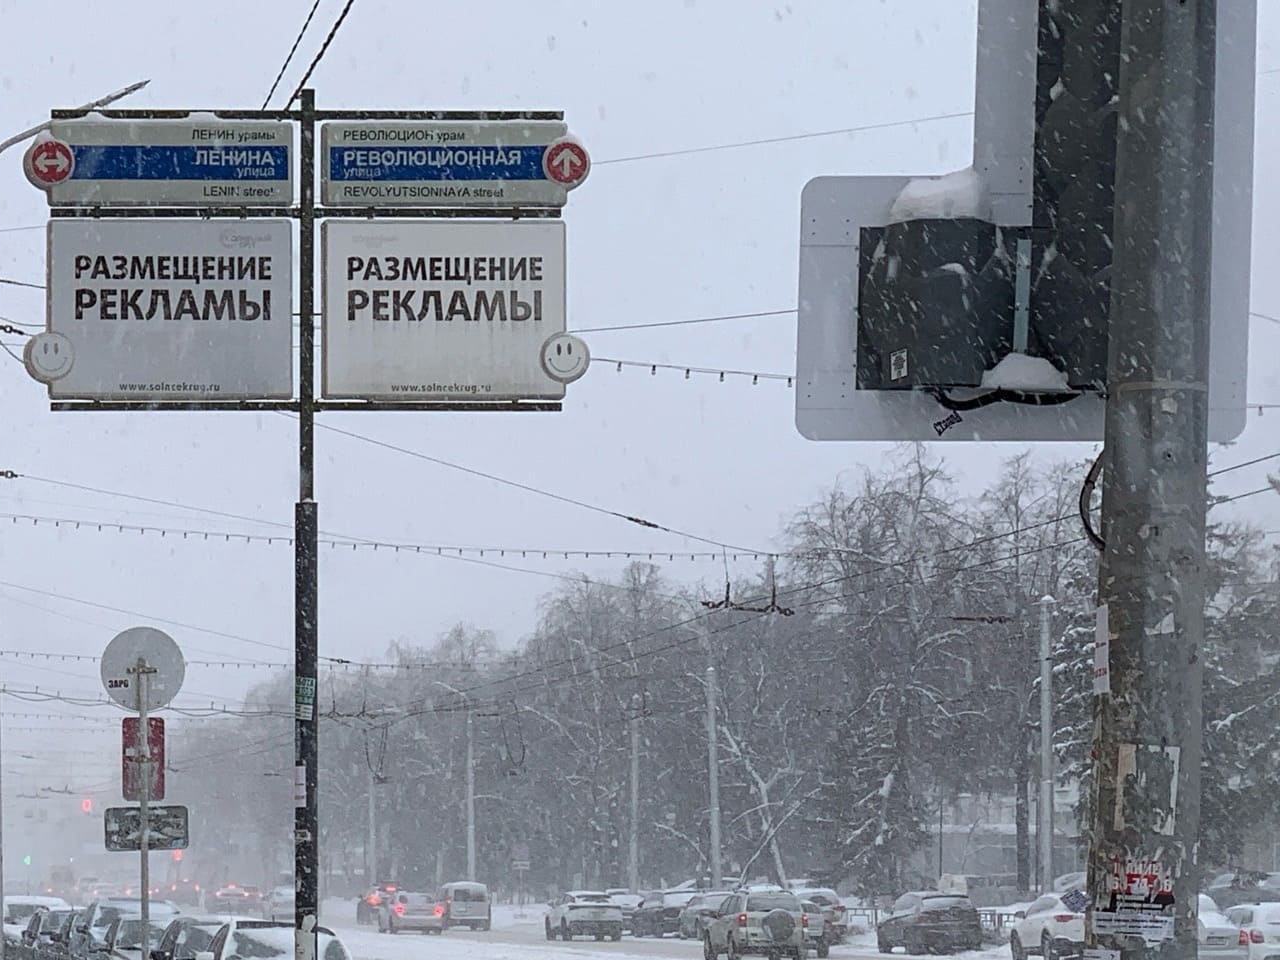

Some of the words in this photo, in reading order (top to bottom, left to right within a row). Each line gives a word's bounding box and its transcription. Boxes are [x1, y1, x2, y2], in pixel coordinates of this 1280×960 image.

[192, 129, 235, 140] ЛЕНИН
[238, 131, 276, 142] урамы
[343, 129, 434, 143] РЕВОЛЮЦИОН
[437, 132, 465, 142] урам
[195, 150, 276, 166] ЛЕНИНА
[343, 150, 522, 168] РЕВОЛЮЦИОННАЯ
[236, 167, 275, 178] улица
[343, 167, 382, 179] улица
[203, 186, 240, 197] LENIN
[343, 186, 471, 198] REVOLYUTSIONNAYA
[473, 187, 504, 198] street
[74, 255, 272, 284] РАЗМЕЩЕНИЕ
[347, 256, 543, 285] РАЗМЕЩЕНИЕ
[74, 288, 272, 321] РЕКЛАМЫ
[347, 290, 543, 322] РЕКЛАМЫ
[119, 382, 220, 393] www.solncekrug.ru
